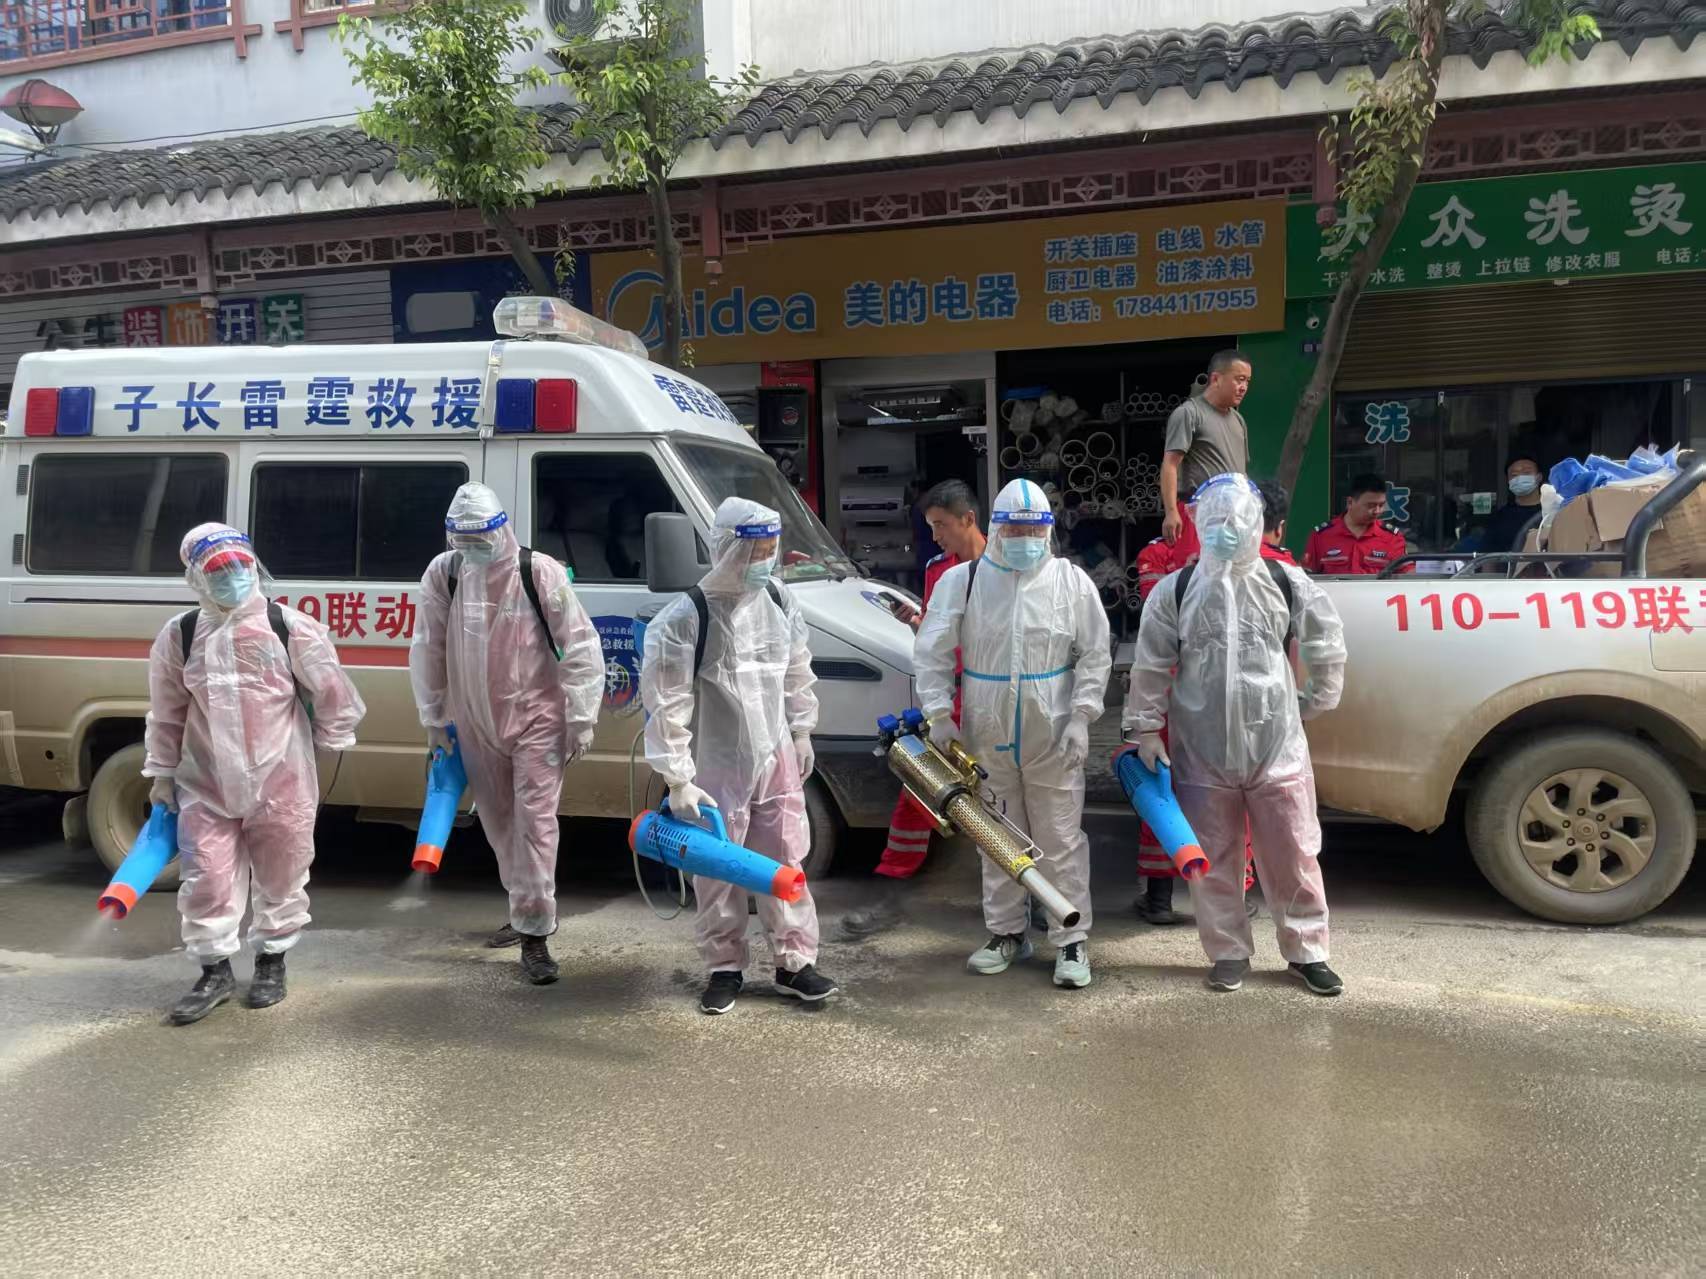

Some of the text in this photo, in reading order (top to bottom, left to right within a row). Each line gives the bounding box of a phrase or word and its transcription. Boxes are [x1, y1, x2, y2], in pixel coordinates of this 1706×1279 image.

[1045, 220, 1265, 262] 开关插座 电线 水管
[1045, 255, 1255, 294] 厨卫电器 油漆涂料
[1426, 260, 1463, 280] 整烫
[1476, 256, 1531, 277] 上拉链
[1545, 250, 1622, 274] 修改衣服
[844, 272, 1020, 328] 美的电器
[1114, 288, 1258, 319] 17844117955
[114, 376, 482, 432] 子长雷霆救援
[1386, 585, 1706, 635] 110-119联
